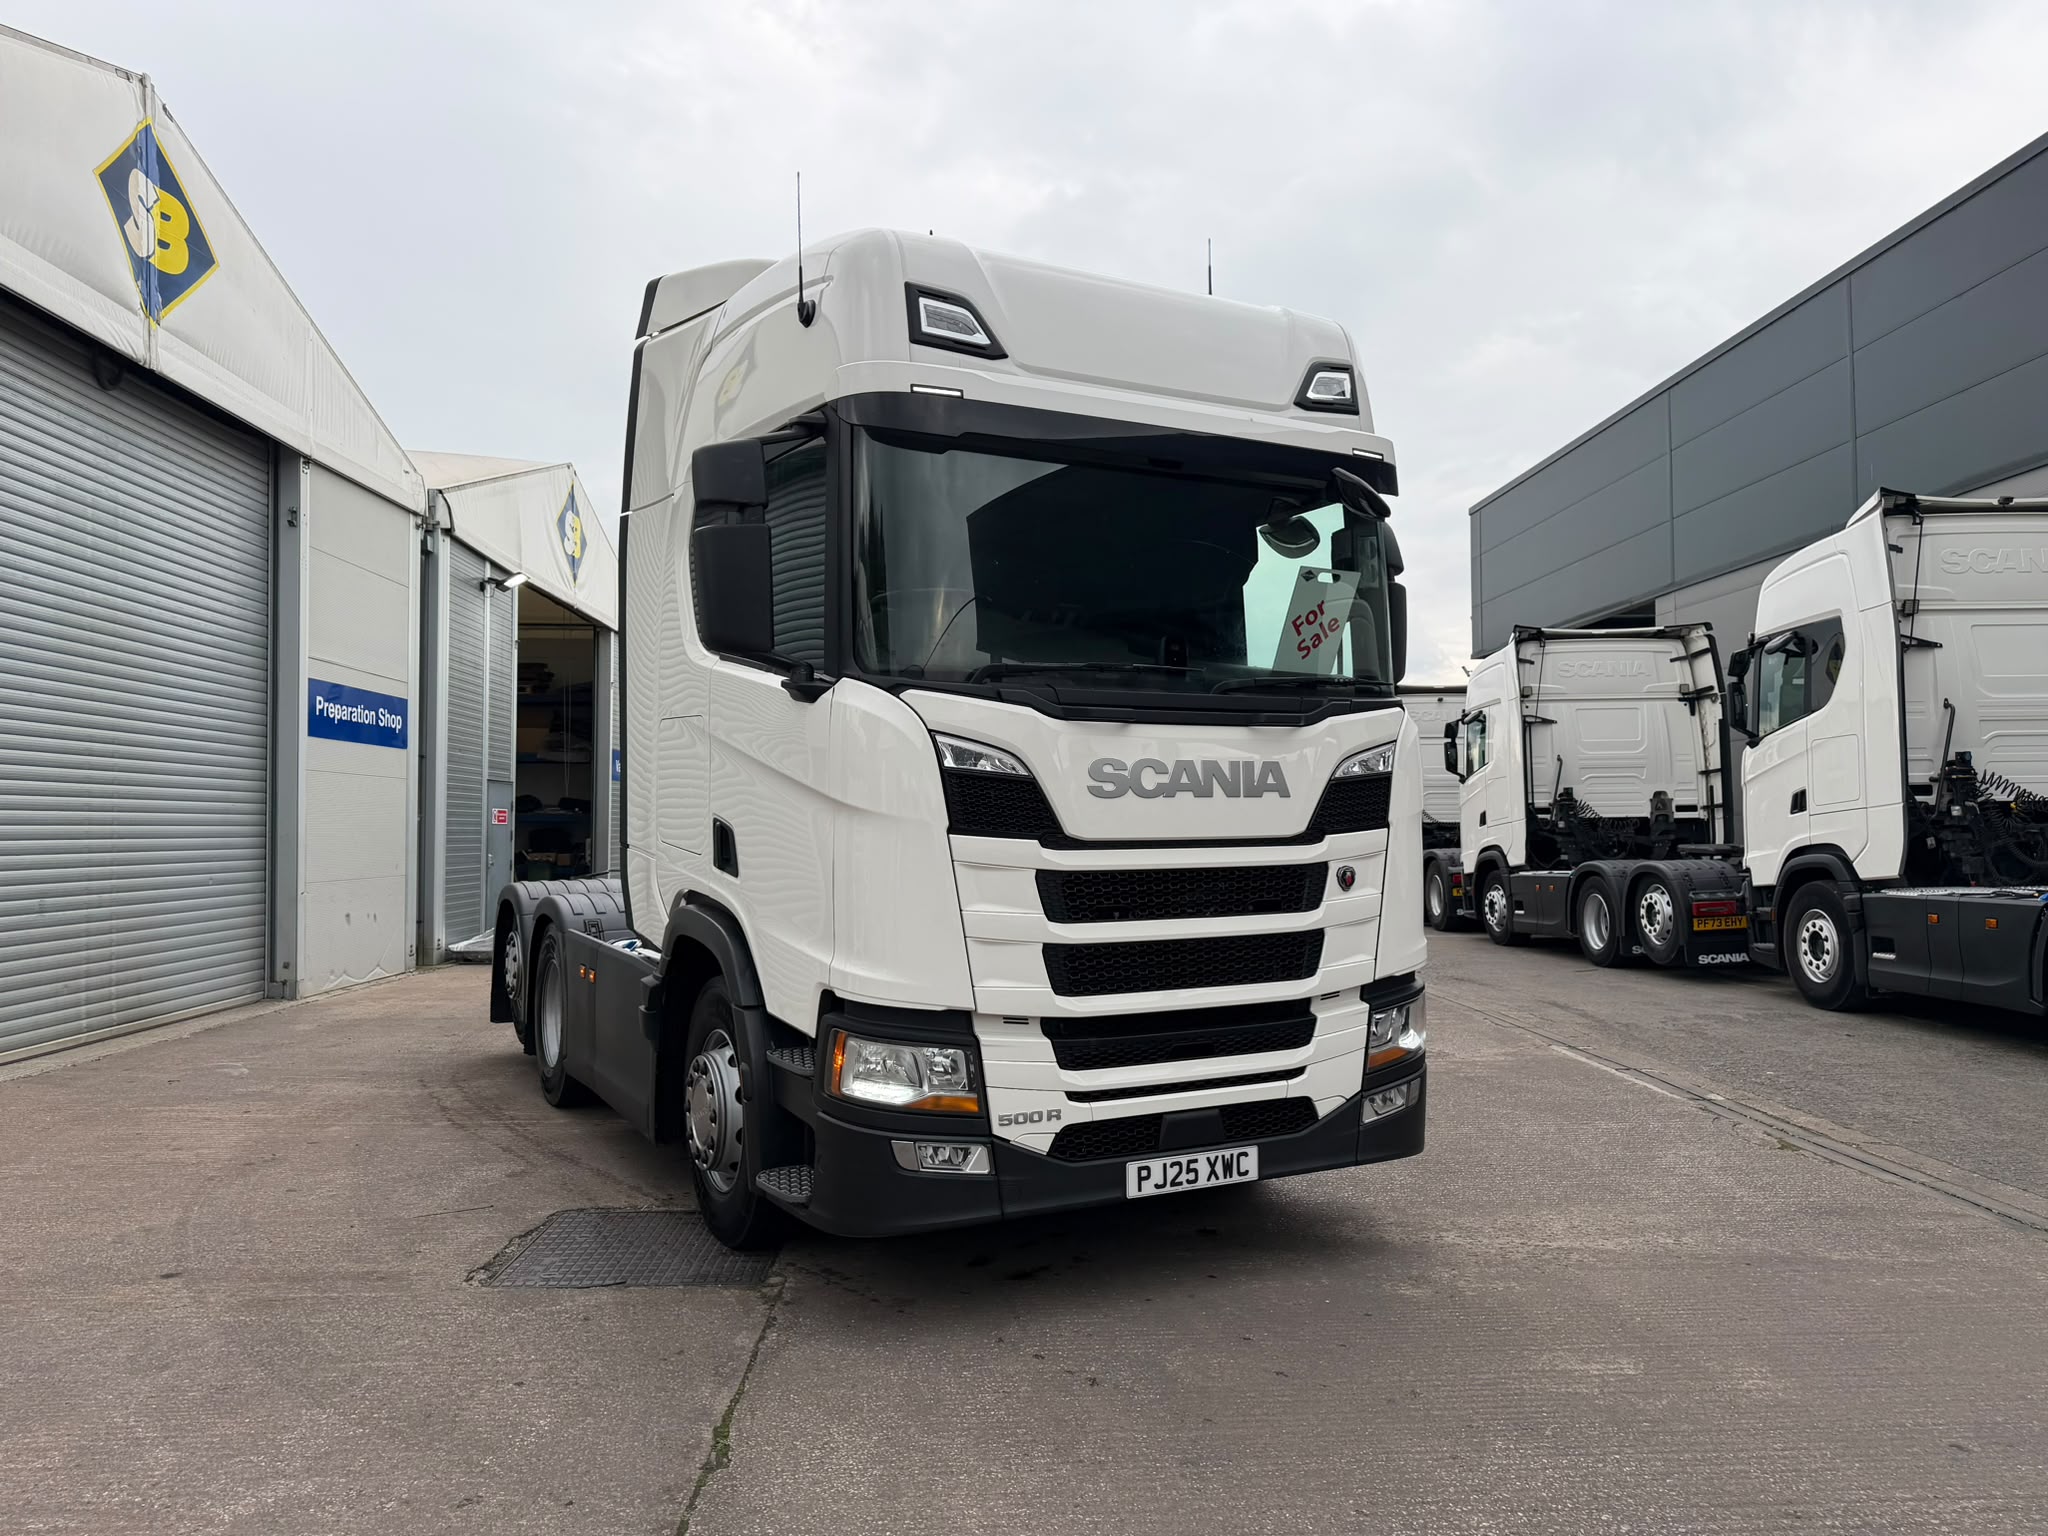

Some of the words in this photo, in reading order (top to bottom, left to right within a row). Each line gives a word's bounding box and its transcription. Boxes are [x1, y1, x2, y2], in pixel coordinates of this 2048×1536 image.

[1292, 600, 1325, 637] For
[1297, 617, 1340, 660] Sale
[1558, 660, 1652, 678] SCANIA
[316, 695, 376, 725] Preparation
[378, 707, 403, 734] Shop
[1087, 757, 1291, 799] SCANIA
[1697, 918, 1723, 929] PF73
[1724, 916, 1743, 927] EHY
[1698, 953, 1750, 964] SCANIA
[998, 1110, 1044, 1126] 500
[1047, 1109, 1062, 1122] R
[1137, 1158, 1199, 1193] PJ25
[1206, 1151, 1250, 1182] XWC
